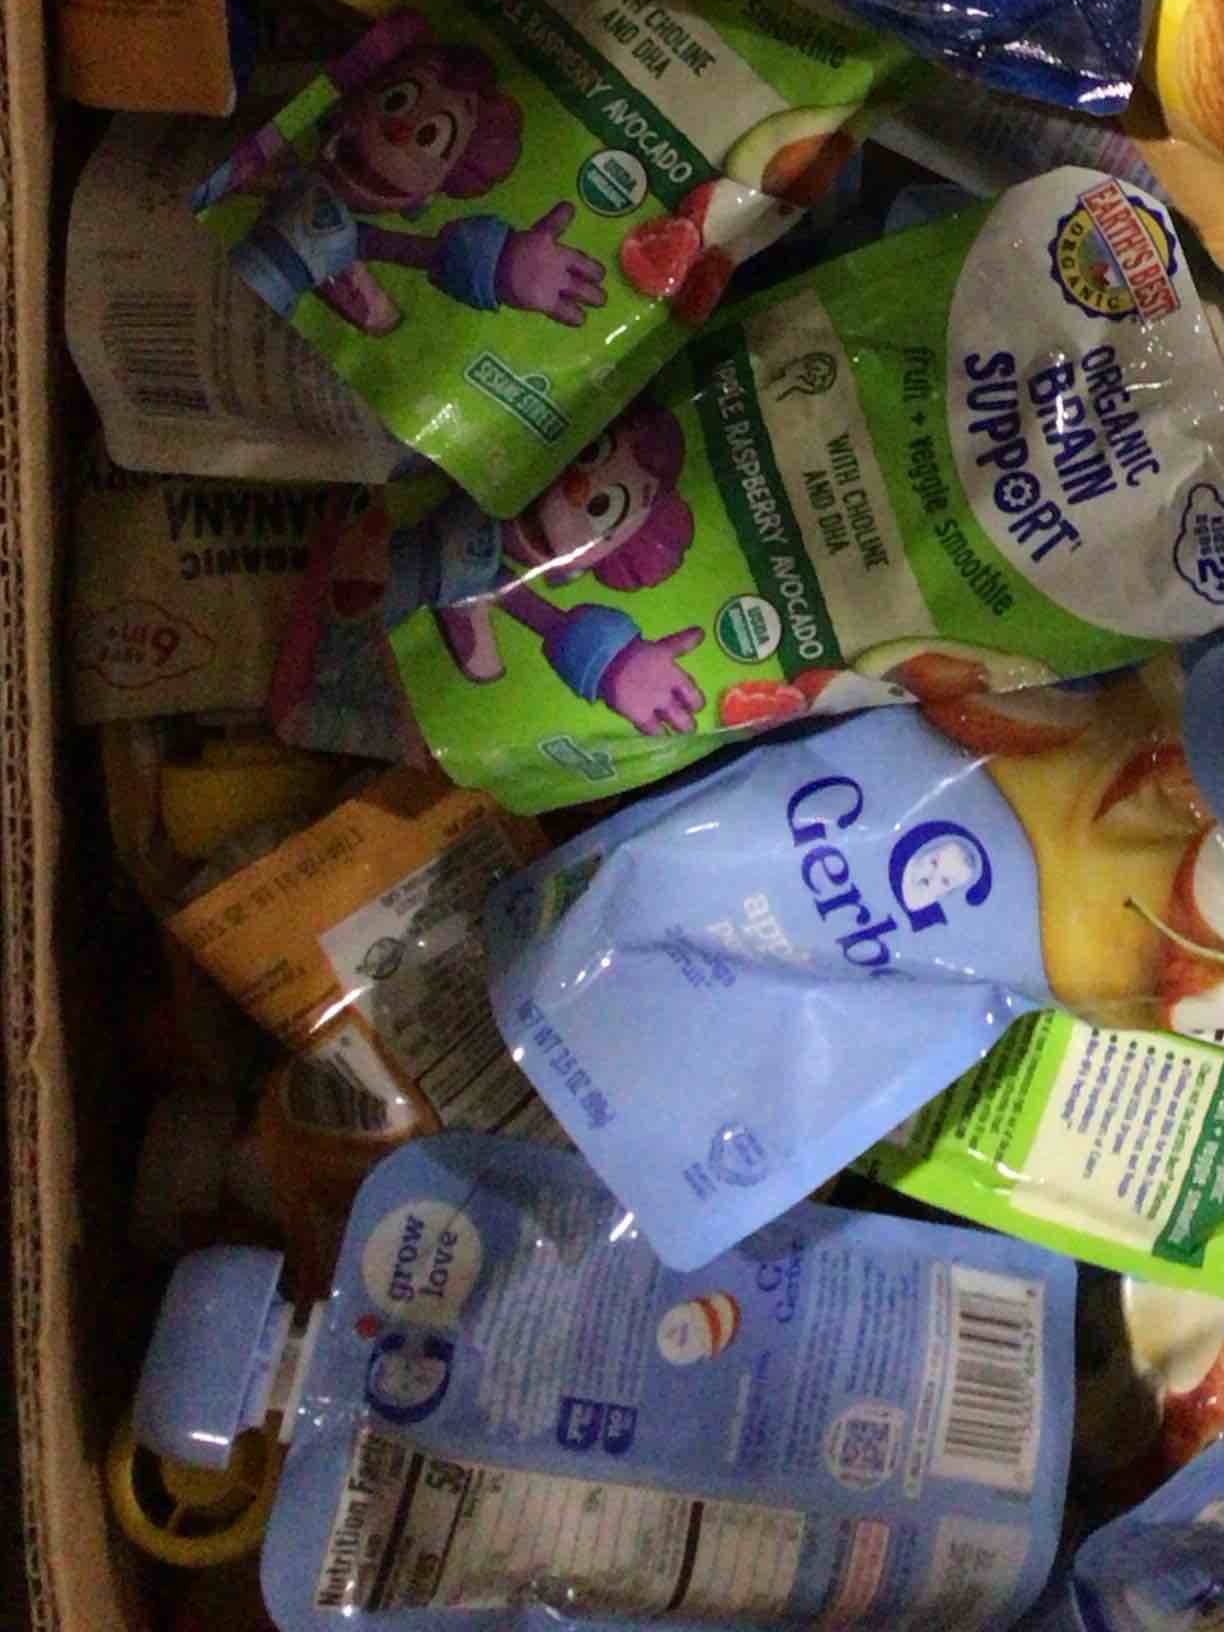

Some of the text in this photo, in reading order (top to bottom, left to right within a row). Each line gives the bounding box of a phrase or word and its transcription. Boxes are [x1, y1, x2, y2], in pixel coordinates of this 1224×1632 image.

[597, 4, 672, 83] AND DHA
[643, 3, 718, 79] CHOLINE
[602, 92, 694, 189] AVOCADO
[1083, 181, 1180, 323] EARTH'S BEST
[954, 342, 1079, 563] SUPPORT
[1020, 361, 1119, 509] BRAIN
[1075, 342, 1165, 488] ORGANIC
[721, 417, 828, 662] RASPBERRY AVOCADO
[798, 465, 854, 556] AND DHA
[823, 433, 893, 572] WITH CHOLINE
[899, 436, 953, 518] veggie
[930, 516, 1017, 621] smoothie
[742, 603, 773, 645] USDA
[383, 1210, 432, 1302] grow
[420, 1227, 463, 1299] love
[317, 1494, 370, 1609] Nutrition
